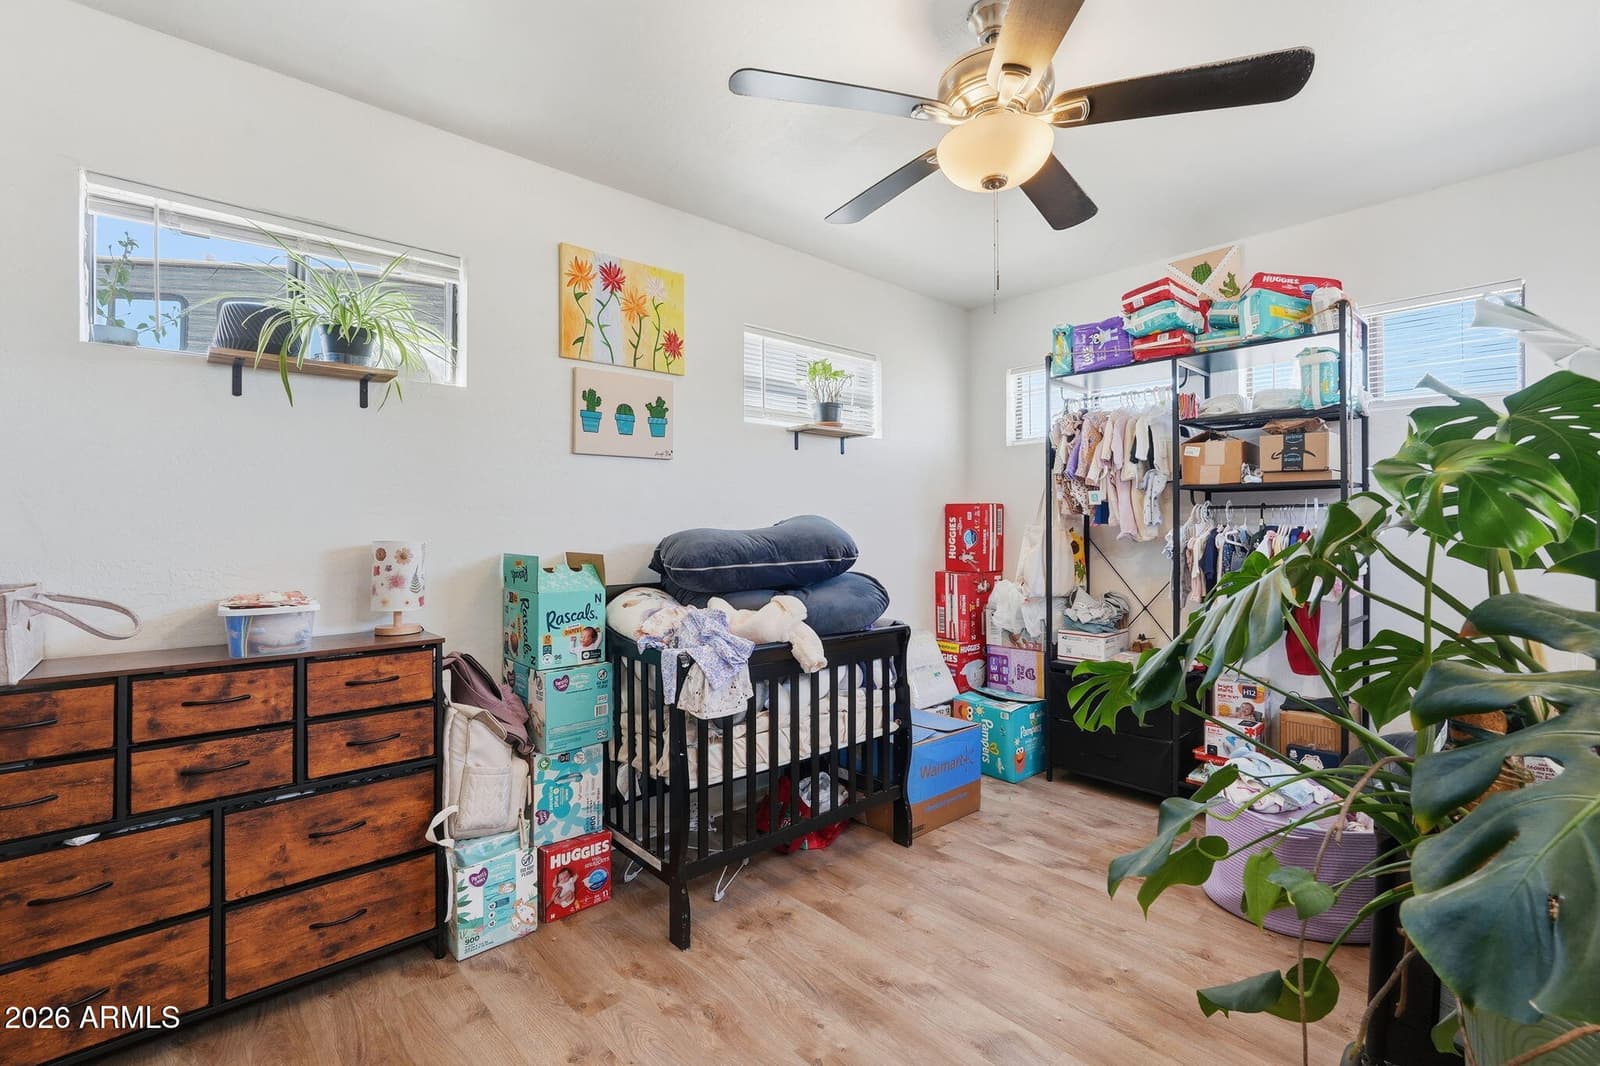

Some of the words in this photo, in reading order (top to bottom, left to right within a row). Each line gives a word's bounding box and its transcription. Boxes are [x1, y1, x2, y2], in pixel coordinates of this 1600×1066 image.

[1262, 275, 1299, 284] HUGGIES
[948, 516, 957, 559] HUGGIES
[594, 593, 602, 603] N
[520, 597, 532, 655] Rascals
[982, 719, 994, 764] Pampers
[920, 756, 965, 779] Walmart
[550, 840, 610, 870] HUGGIES
[465, 935, 480, 945] 900
